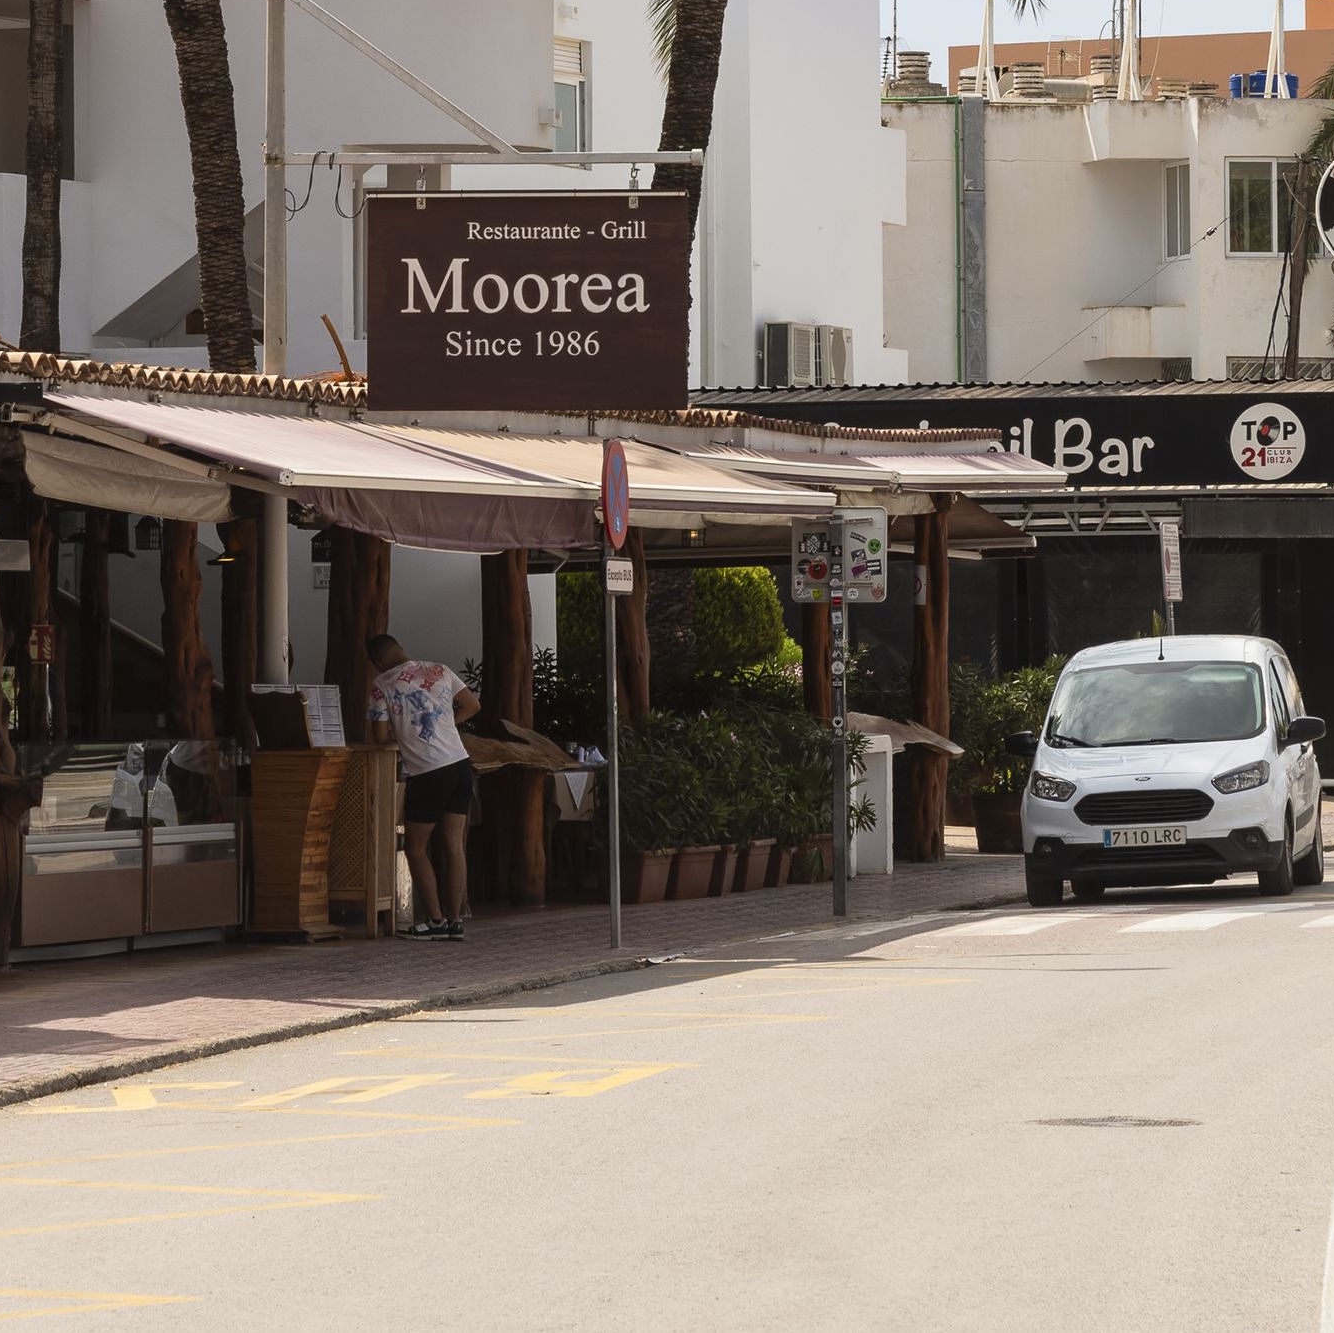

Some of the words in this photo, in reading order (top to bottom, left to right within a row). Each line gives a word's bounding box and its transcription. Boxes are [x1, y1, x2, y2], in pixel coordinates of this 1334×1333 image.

[467, 222, 581, 241] Restaurante
[601, 221, 647, 240] Grill
[400, 257, 651, 315] Moorea
[445, 331, 522, 358] Since
[534, 330, 601, 357] 1986
[1241, 416, 1298, 447] TOP
[1052, 417, 1155, 478] Bar
[1241, 447, 1267, 468] 21
[1267, 456, 1293, 464] IBIZA
[622, 569, 632, 582] BUS
[1112, 830, 1149, 846] 7110
[1154, 829, 1182, 844] LRC
